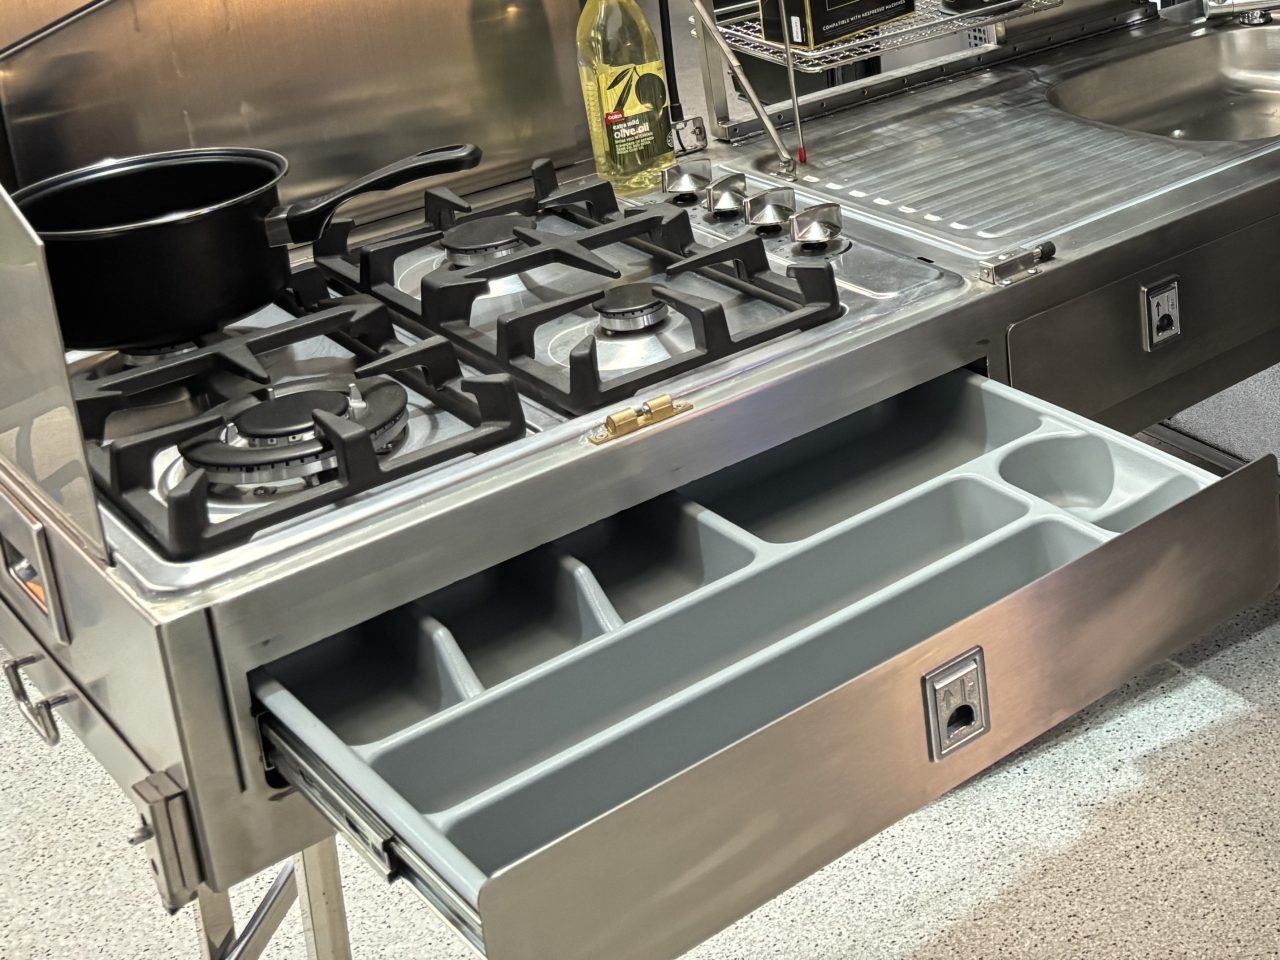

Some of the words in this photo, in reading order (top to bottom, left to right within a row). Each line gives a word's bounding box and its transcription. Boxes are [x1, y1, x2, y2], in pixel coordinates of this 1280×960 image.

[822, 20, 850, 31] COMPATIBLE
[850, 14, 862, 23] WITH
[862, 6, 885, 18] NESPRESSO
[885, 0, 906, 10] MACHINES
[614, 127, 637, 139] olive
[638, 122, 650, 133] oil
[627, 118, 640, 127] mild
